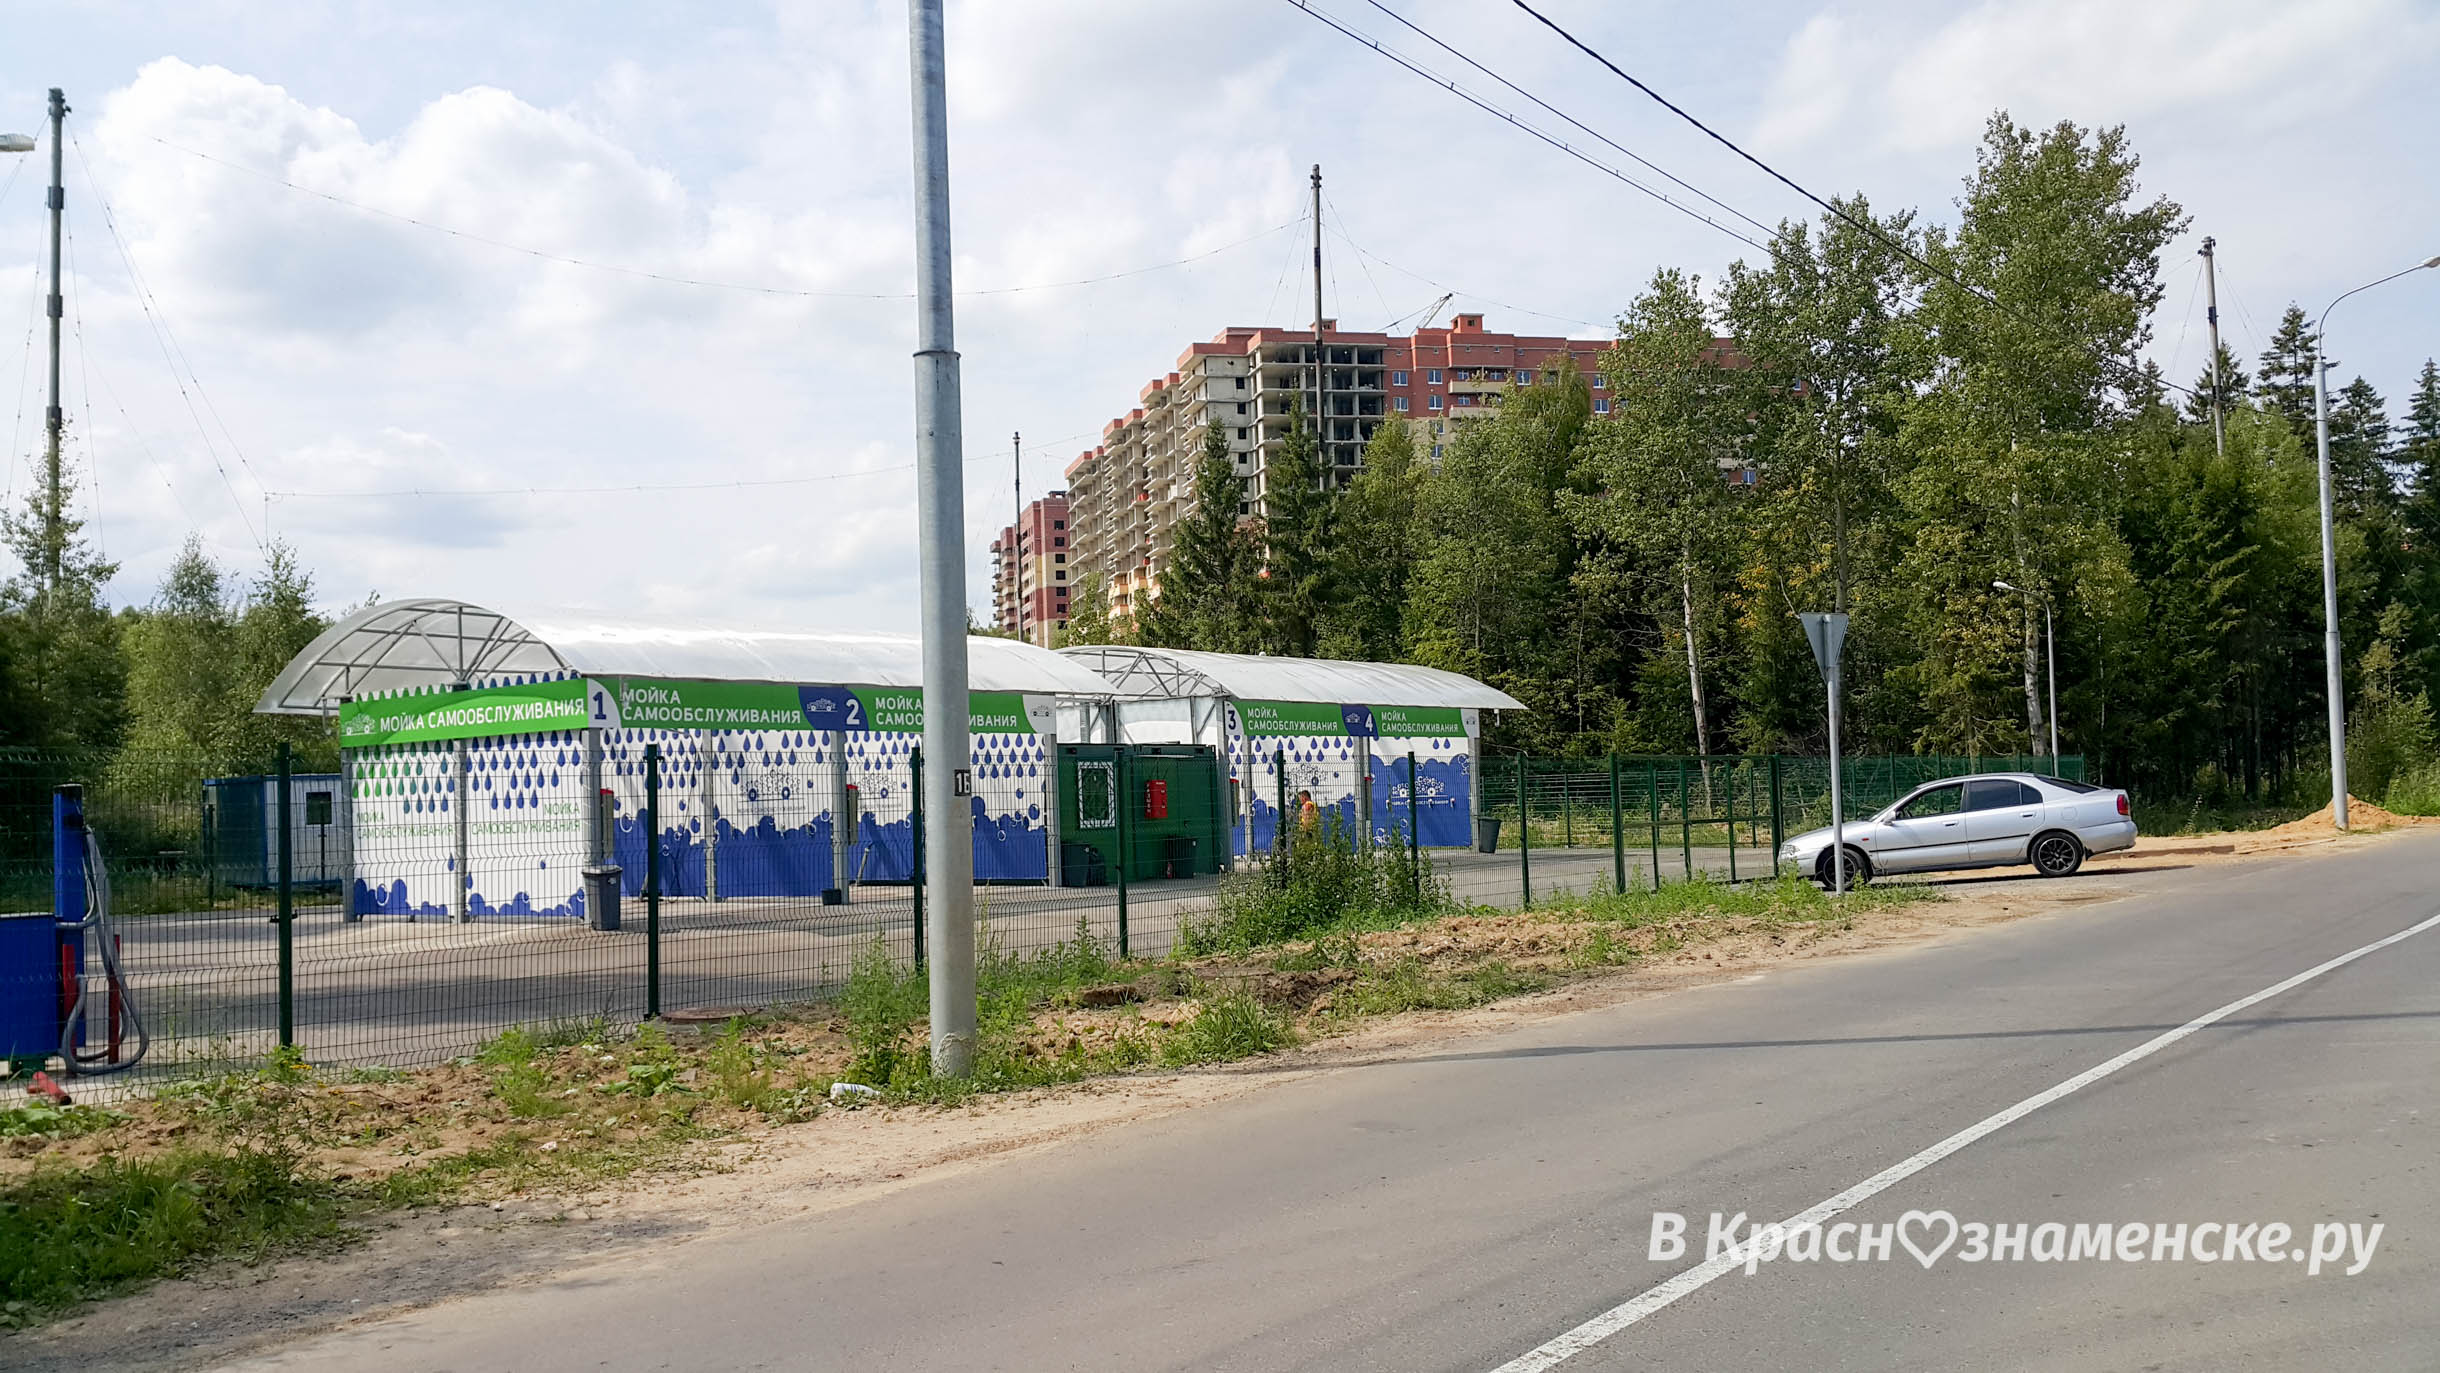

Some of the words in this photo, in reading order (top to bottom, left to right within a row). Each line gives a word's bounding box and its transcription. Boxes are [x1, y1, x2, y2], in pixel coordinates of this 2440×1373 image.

[622, 686, 681, 704] МОЙКА
[875, 695, 923, 711] МОЙКА
[593, 691, 607, 720] 1
[846, 699, 860, 726] 2
[1248, 706, 1278, 718] МОЙКА
[380, 712, 425, 733] МОЙКА
[428, 698, 585, 729] САМООБСЛУЖИВАНИЯ
[622, 706, 801, 724] САМООБСЛУЖИВАНИЯ
[1228, 710, 1236, 730] 3
[1365, 713, 1374, 732] 4
[1381, 710, 1407, 722] МОЙКА
[1248, 720, 1338, 732] САМООБСЛУЖИВАНИЯ
[1381, 722, 1459, 733] САМООБСЛУЖИВАНИЯ
[356, 810, 385, 824] МОЙКА
[543, 803, 581, 816] МОЙКА
[357, 824, 454, 840] САМООБСЛУЖИВАНИЯ
[471, 818, 581, 836] САМООБСЛУЖИВАНИЯ
